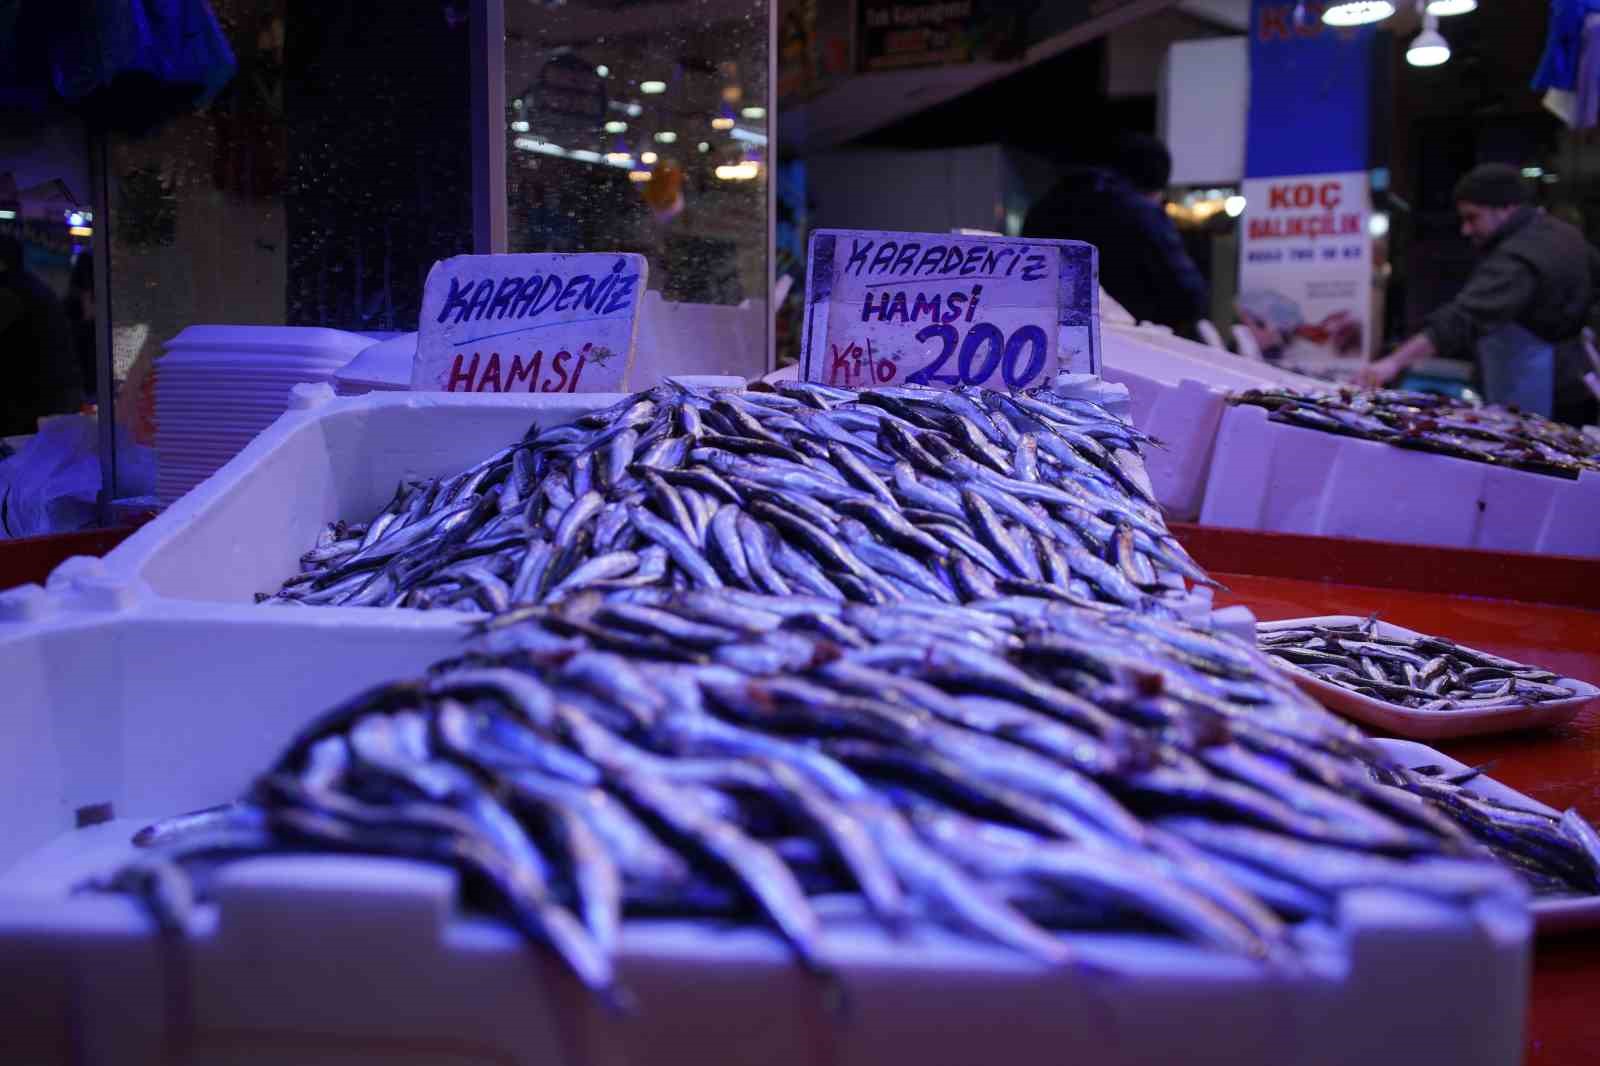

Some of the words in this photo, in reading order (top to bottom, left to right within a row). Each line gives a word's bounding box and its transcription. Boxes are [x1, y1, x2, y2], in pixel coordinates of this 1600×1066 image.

[1269, 181, 1343, 211] KOÇ
[436, 258, 639, 324] KARADENİZ
[904, 322, 1049, 389] 200
